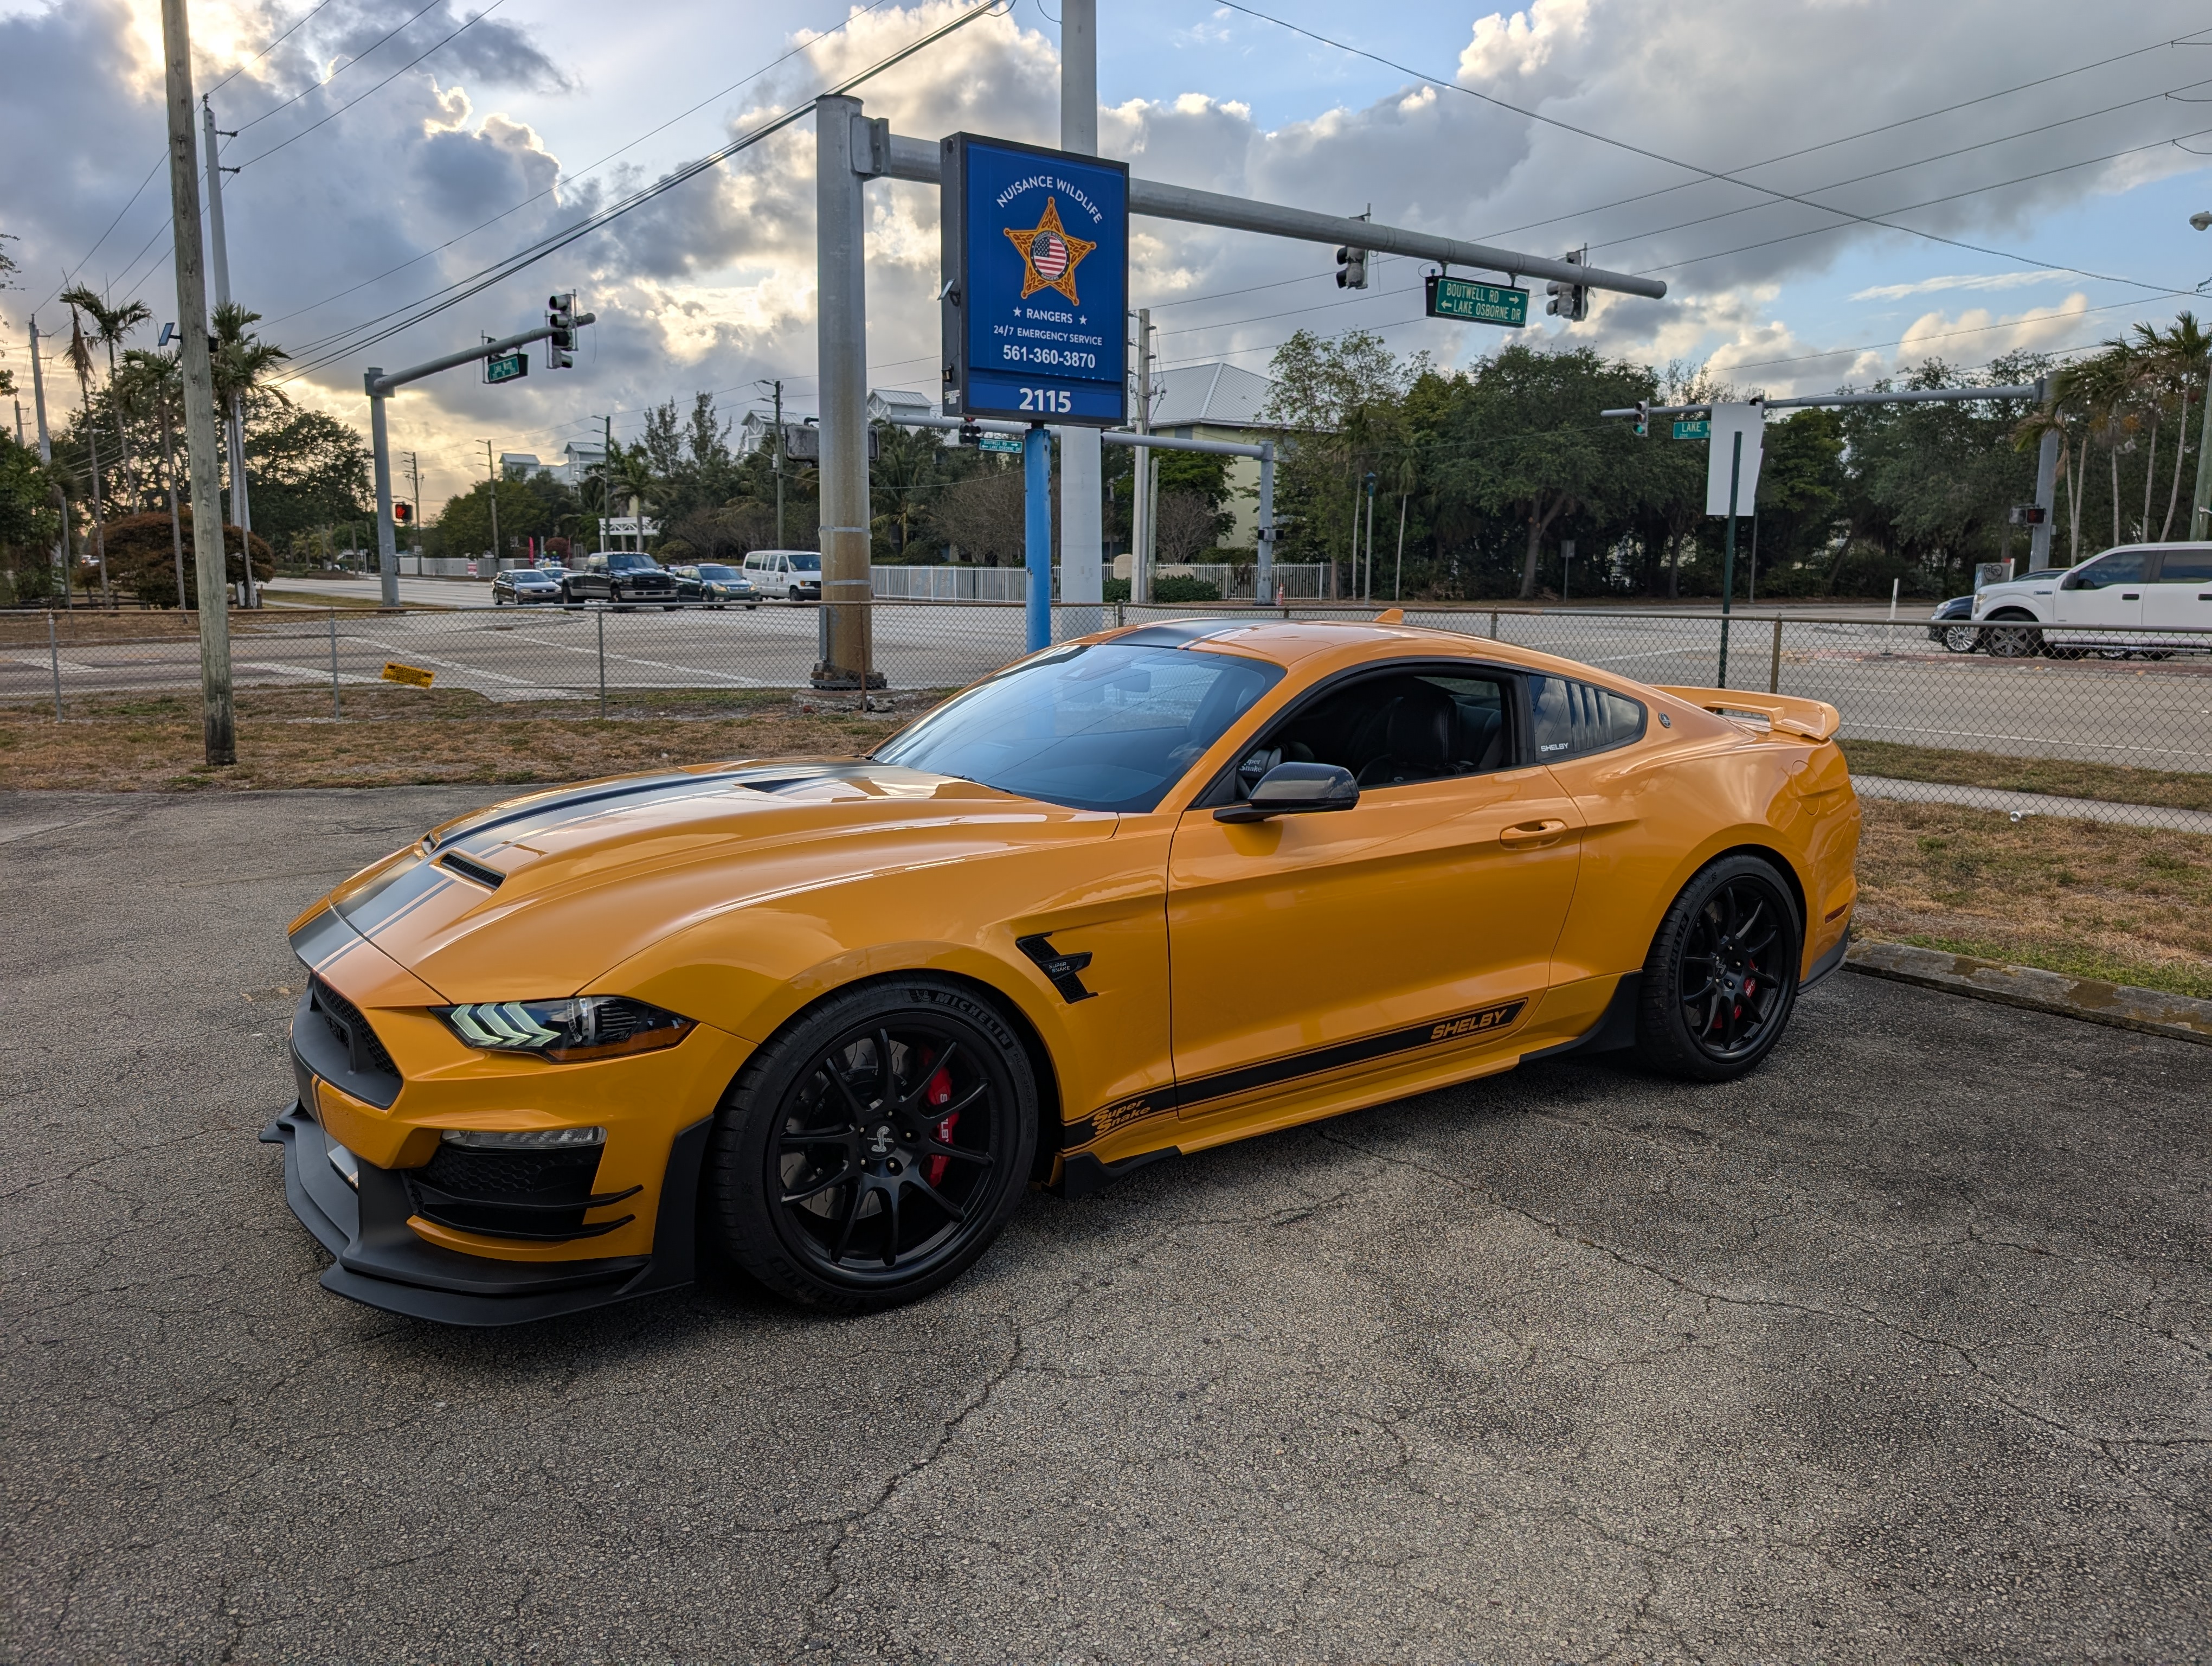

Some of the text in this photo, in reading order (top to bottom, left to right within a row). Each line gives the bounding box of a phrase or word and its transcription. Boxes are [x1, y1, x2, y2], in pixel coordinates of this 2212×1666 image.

[996, 176, 1102, 223] NUISANCE WILDLIFE
[1446, 283, 1499, 303] BOUTWELL RD
[1026, 309, 1072, 324] RANGERS
[1453, 299, 1521, 321] LAKE OSBORNE DR
[994, 325, 1103, 345] 24/7 EMERGENCY SERVICE
[1003, 345, 1095, 368] 561-360-3870
[1019, 388, 1071, 413] 2115
[1682, 422, 1701, 432] LAKE
[1541, 742, 1568, 752] SHELBY
[935, 992, 1011, 1046] MICHELIN
[1431, 1009, 1507, 1040] SHELBY
[1013, 1053, 1026, 1076] PILOT
[1024, 1080, 1033, 1108] SPORT
[1091, 1099, 1145, 1126] Super
[1095, 1107, 1150, 1135] Snake
